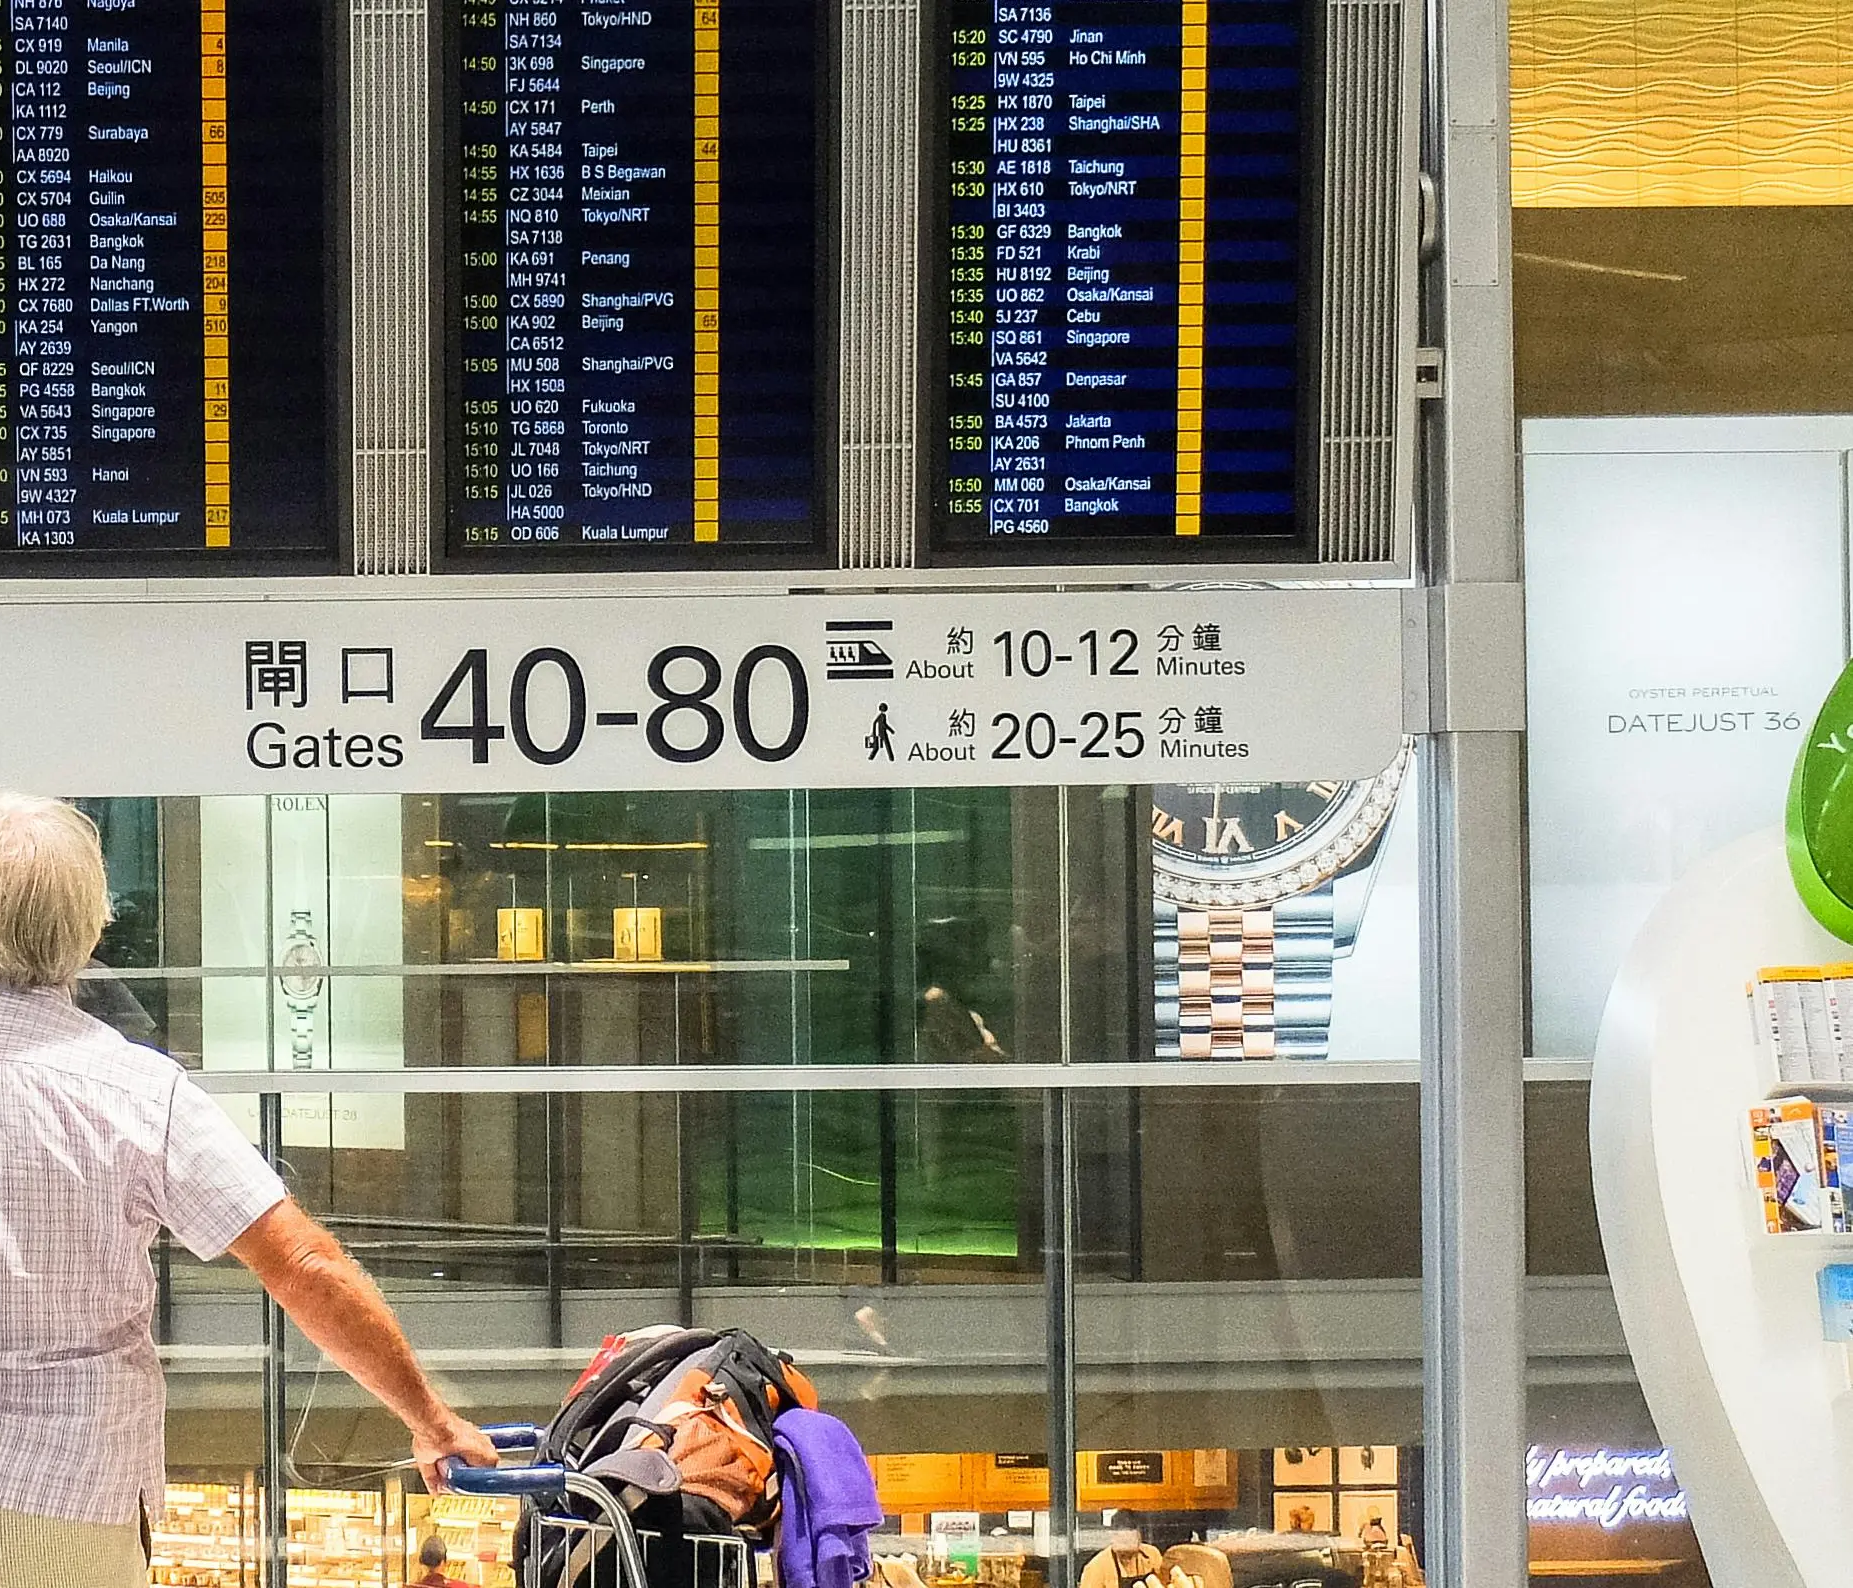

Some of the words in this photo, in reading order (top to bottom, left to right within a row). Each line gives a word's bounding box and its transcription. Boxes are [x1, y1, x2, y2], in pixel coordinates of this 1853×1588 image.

[460, 13, 496, 27] 14:45
[510, 13, 529, 26] NH
[534, 12, 556, 26] 860
[582, 12, 651, 28] Tokyo/HND
[701, 12, 716, 25] 64
[16, 39, 34, 52] CX
[39, 38, 62, 52] 919
[88, 38, 128, 52] Manila
[216, 39, 223, 50] 4
[952, 30, 985, 44] 15:20
[999, 30, 1018, 43] SC
[1021, 30, 1052, 43] 4790
[1070, 29, 1103, 43] Jinan
[951, 52, 985, 66] 15:20
[999, 52, 1018, 65] VN
[1022, 51, 1045, 65] 595
[1070, 51, 1088, 64] Ho
[1091, 51, 1112, 64] Chi
[1116, 51, 1146, 64] Minh
[461, 145, 496, 158] 14:50
[510, 144, 528, 157] KA
[532, 144, 562, 157] 5484
[582, 143, 617, 160] Taipei
[701, 143, 717, 155] 44
[18, 214, 38, 227] UO
[42, 214, 65, 226] 688
[90, 213, 176, 226] Osaka/Kansai
[204, 213, 225, 226] 229
[950, 247, 984, 260] 15:35
[997, 246, 1015, 260] FD
[1019, 246, 1040, 259] 521
[1068, 246, 1100, 259] Krabi
[18, 256, 35, 270] BL
[40, 256, 62, 269] 165
[90, 256, 107, 269] Da
[112, 256, 144, 272] Nang
[205, 255, 226, 268] 218
[948, 374, 982, 386] 15:45
[996, 373, 1016, 386] GA
[1018, 372, 1041, 386] 857
[1066, 372, 1126, 388] Denpasar
[20, 405, 37, 418] VA
[41, 405, 71, 418] 5643
[92, 404, 155, 420] Singapore
[213, 405, 227, 417] 29
[463, 422, 498, 435] 15:10
[511, 421, 530, 434] TG
[534, 421, 564, 434] 5868
[582, 420, 628, 434] Toronto
[948, 478, 982, 492] 15:50
[995, 478, 1018, 491] MM
[1021, 478, 1044, 491] 060
[1065, 477, 1150, 491] Osaka/Kansai
[464, 528, 498, 540] 15:15
[511, 527, 532, 540] OD
[536, 526, 558, 540] 606
[582, 526, 617, 539] Kuala
[622, 526, 668, 541] Lumpur
[947, 627, 975, 656] 約
[1155, 623, 1223, 654] 分鐘
[994, 629, 1141, 679] 10-12
[905, 661, 975, 680] About
[1157, 656, 1247, 677] Minutes
[246, 641, 395, 712] 閘口
[1629, 687, 1686, 699] OYSTER
[1692, 686, 1779, 699] PERPETUAL
[421, 645, 811, 767] 40-80
[948, 709, 976, 739] 約
[1156, 706, 1225, 736] 分鐘
[1608, 712, 1756, 734] DATEJUST
[1763, 711, 1801, 732] 36
[992, 712, 1146, 761] 20-25
[247, 723, 405, 771] Gates
[908, 743, 977, 763] About
[1161, 740, 1250, 759] Minutes
